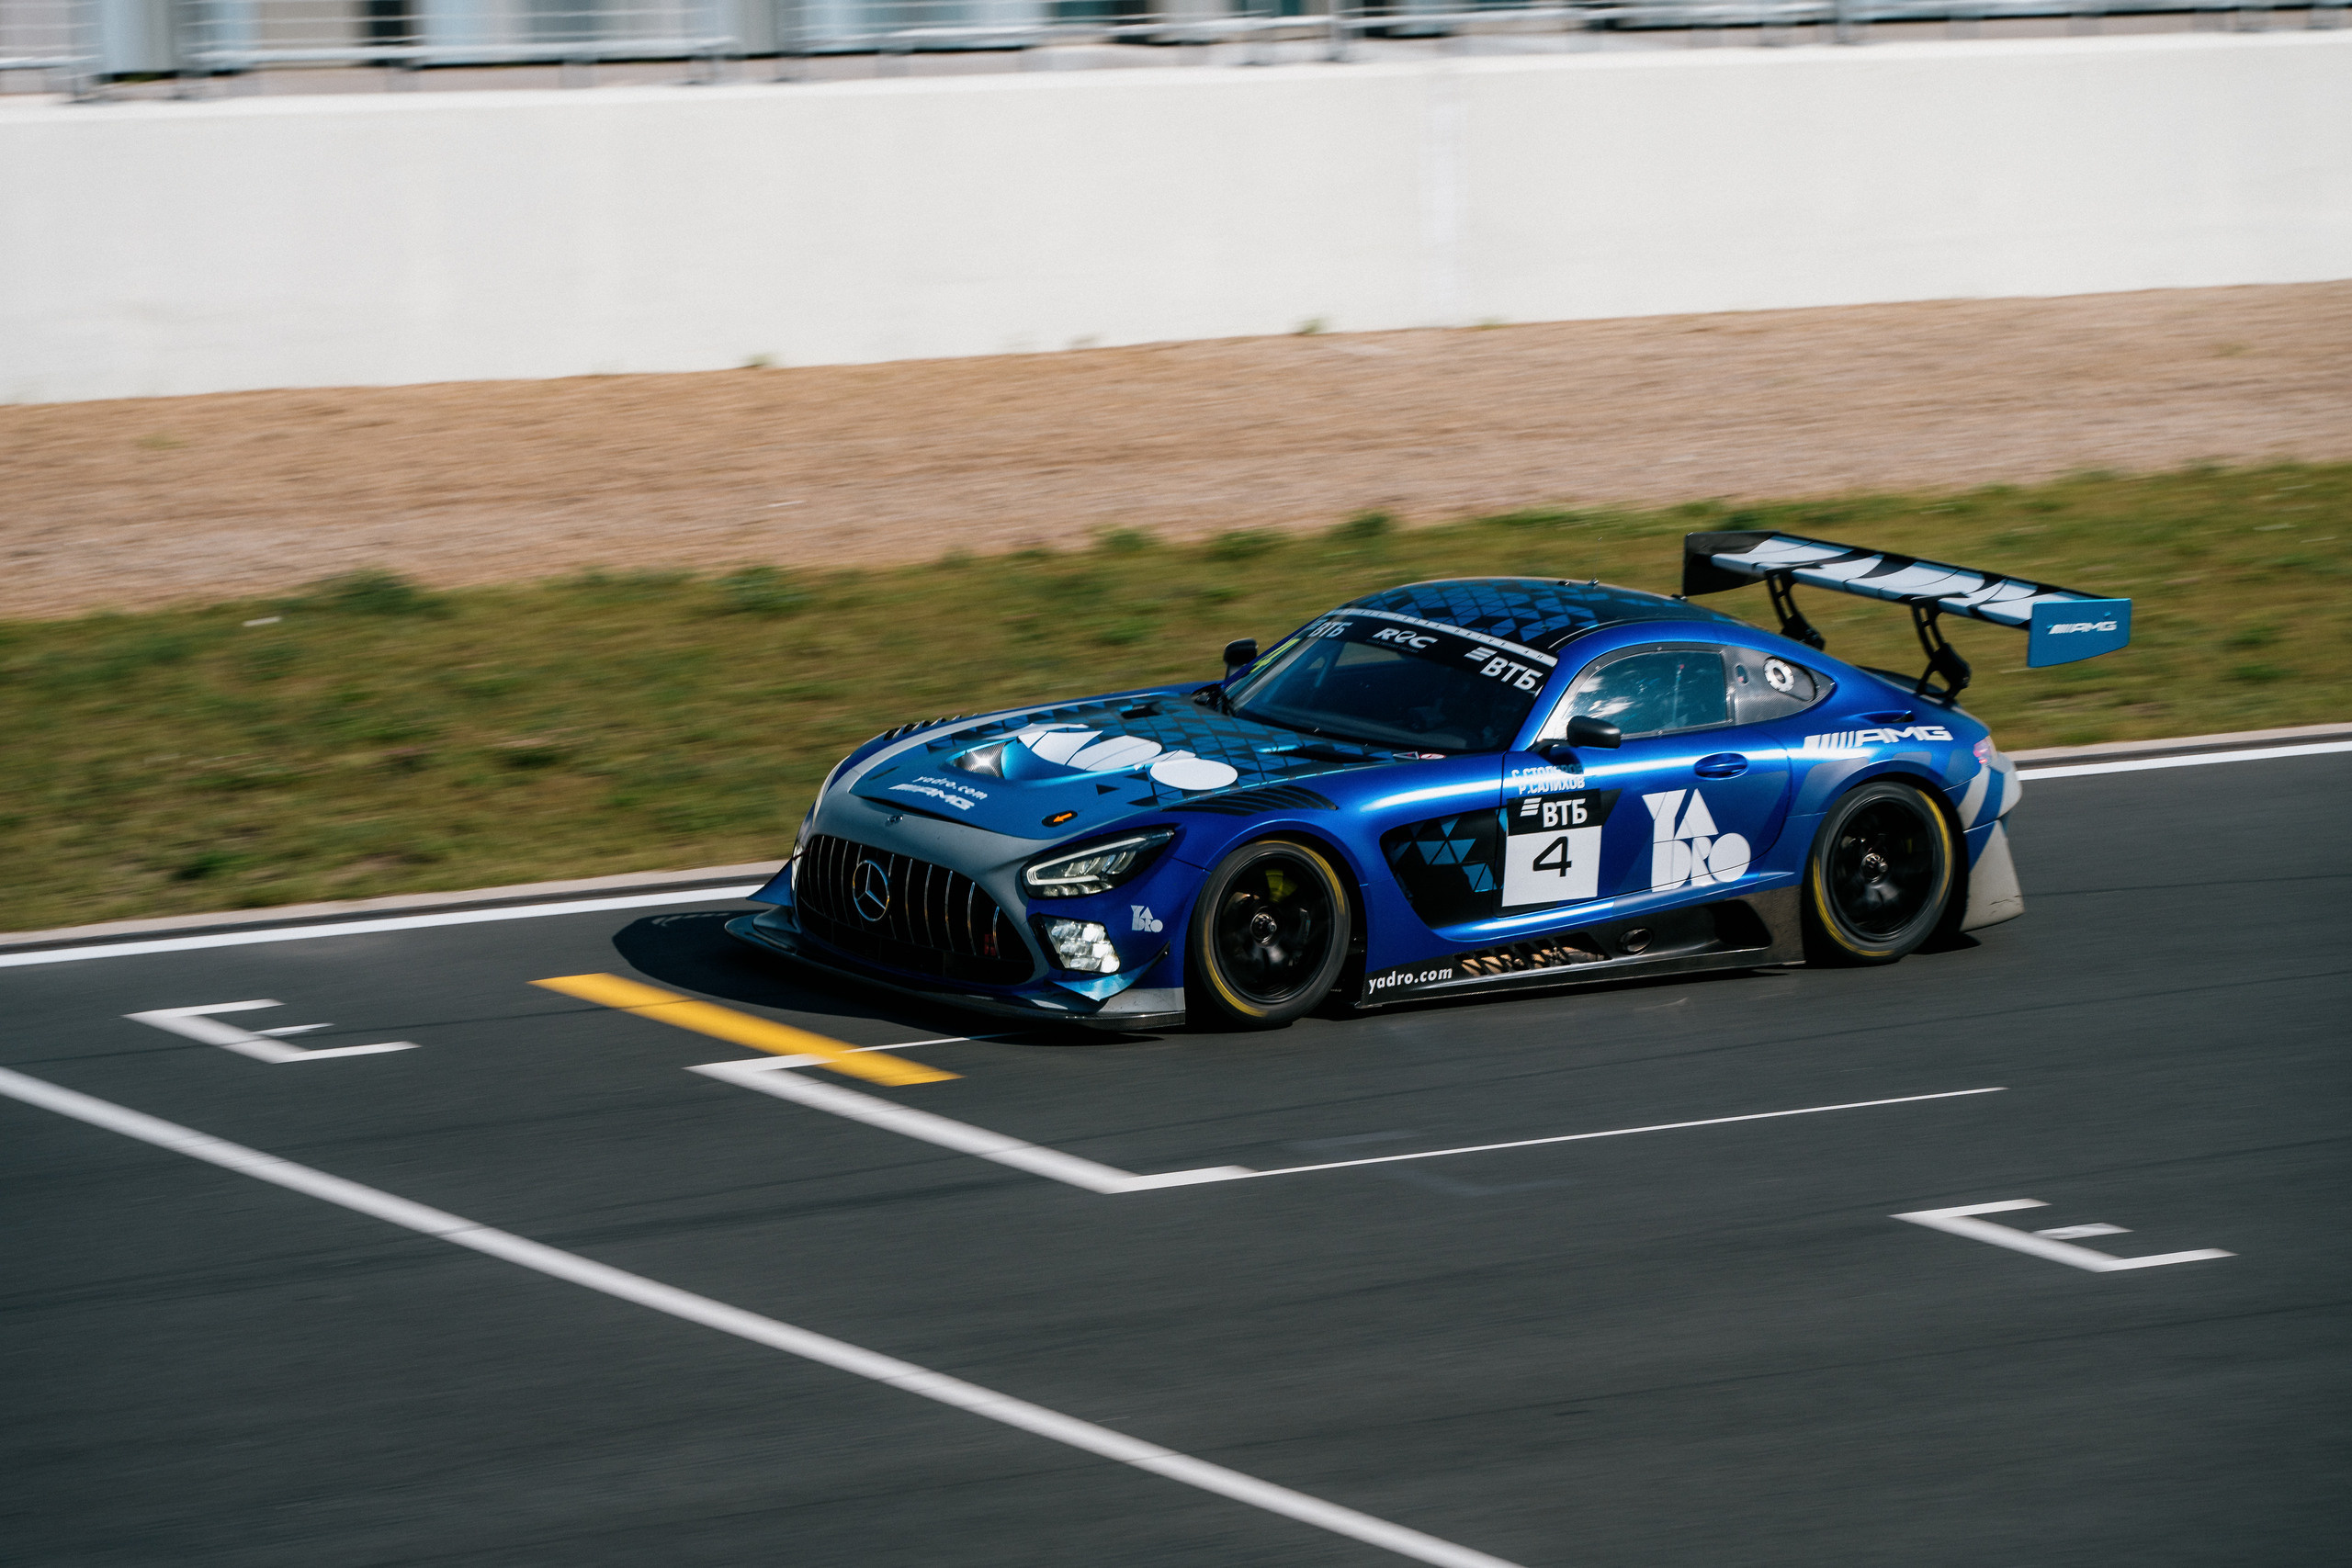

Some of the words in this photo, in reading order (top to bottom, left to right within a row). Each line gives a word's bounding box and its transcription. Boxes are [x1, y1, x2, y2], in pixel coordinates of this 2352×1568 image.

[1307, 621, 1353, 637] ВТБ
[1480, 656, 1544, 691] ВТБ
[912, 776, 988, 800] yadro.com
[1543, 798, 1588, 828] ВТБ
[1532, 836, 1572, 877] 4
[1369, 967, 1453, 995] yadro.com
